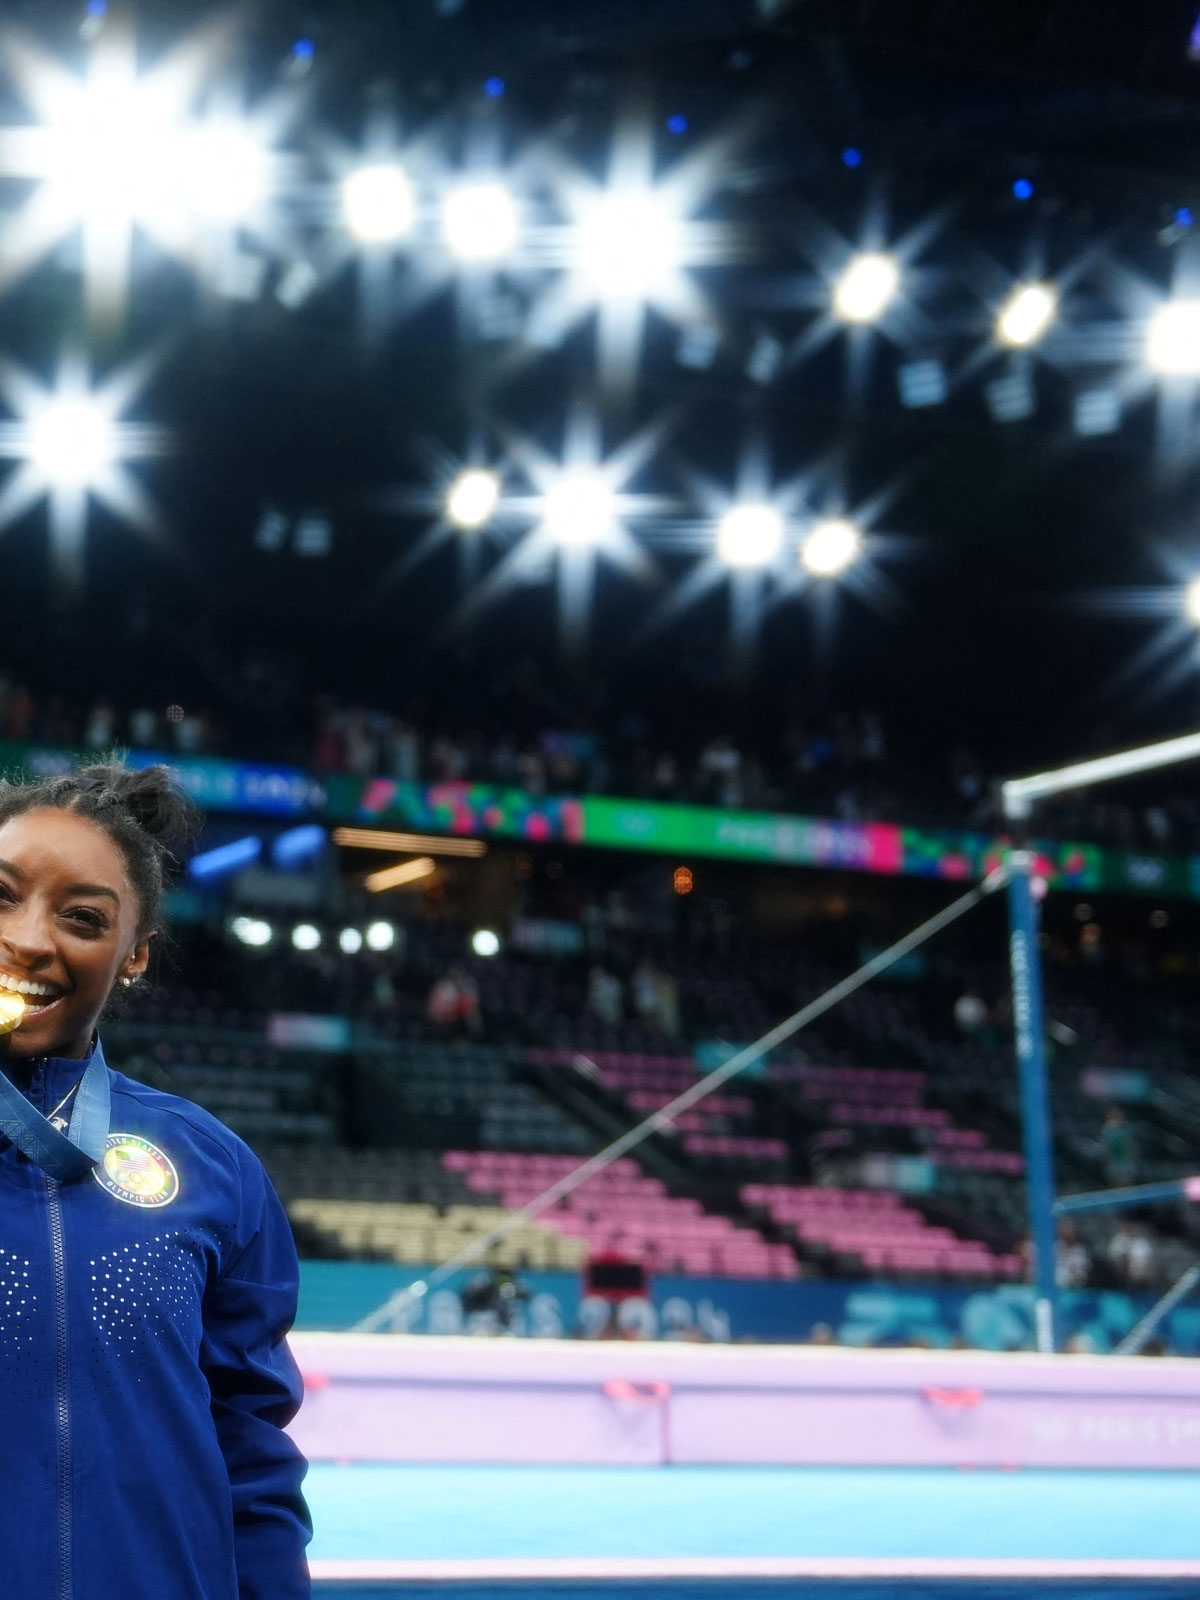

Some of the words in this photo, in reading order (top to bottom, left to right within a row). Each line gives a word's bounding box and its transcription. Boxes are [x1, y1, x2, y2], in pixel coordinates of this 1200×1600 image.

[132, 1139, 163, 1161] STATES
[106, 1181, 146, 1203] OLYMPIC
[149, 1190, 170, 1203] TEAM
